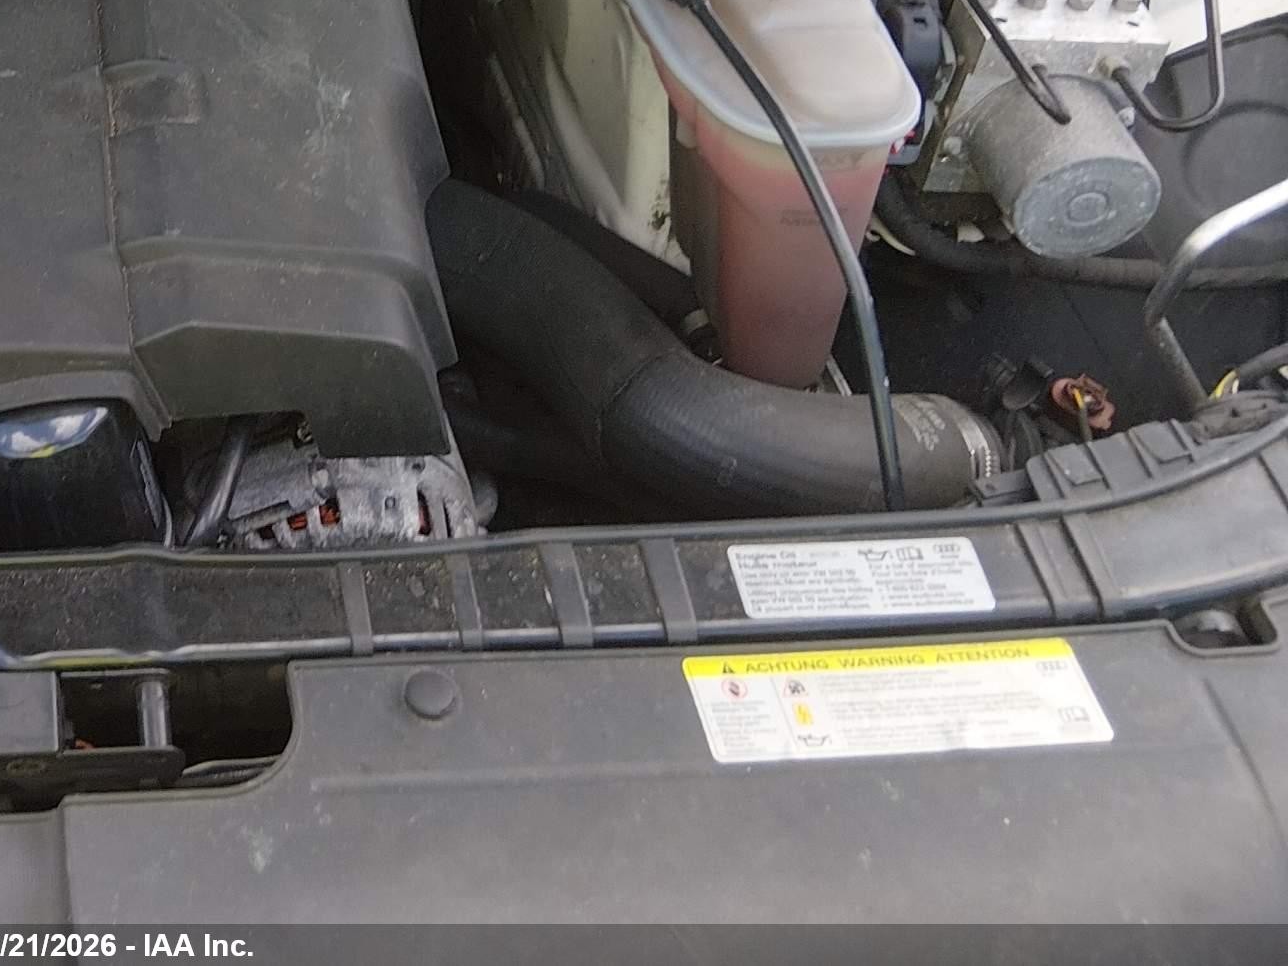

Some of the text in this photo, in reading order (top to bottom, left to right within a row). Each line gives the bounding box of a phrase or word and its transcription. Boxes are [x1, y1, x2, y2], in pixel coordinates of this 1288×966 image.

[745, 646, 1031, 673] ACHTUNG WARNING ATTENTION
